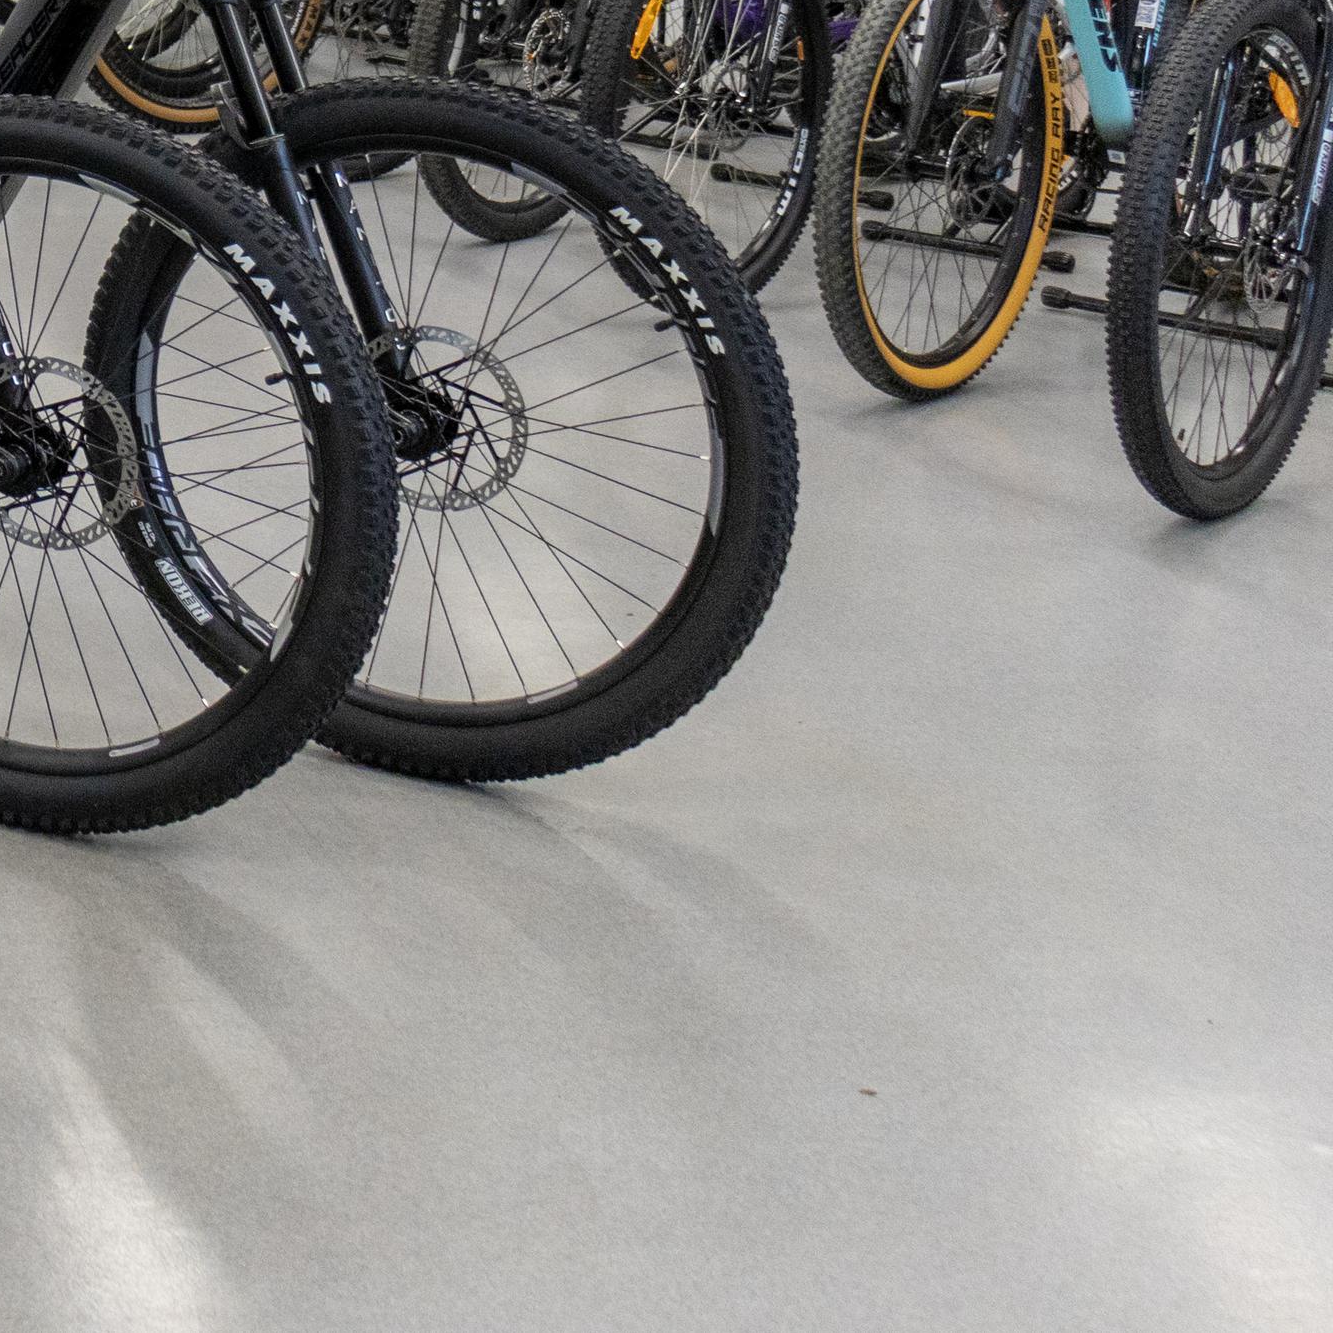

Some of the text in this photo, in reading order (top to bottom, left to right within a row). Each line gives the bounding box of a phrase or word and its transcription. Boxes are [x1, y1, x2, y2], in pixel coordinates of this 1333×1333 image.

[1047, 92, 1061, 140] RAY
[1037, 151, 1063, 234] RACING
[608, 206, 725, 355] MAXXIS
[223, 243, 332, 403] MAXXIS
[155, 556, 213, 626] REKON
